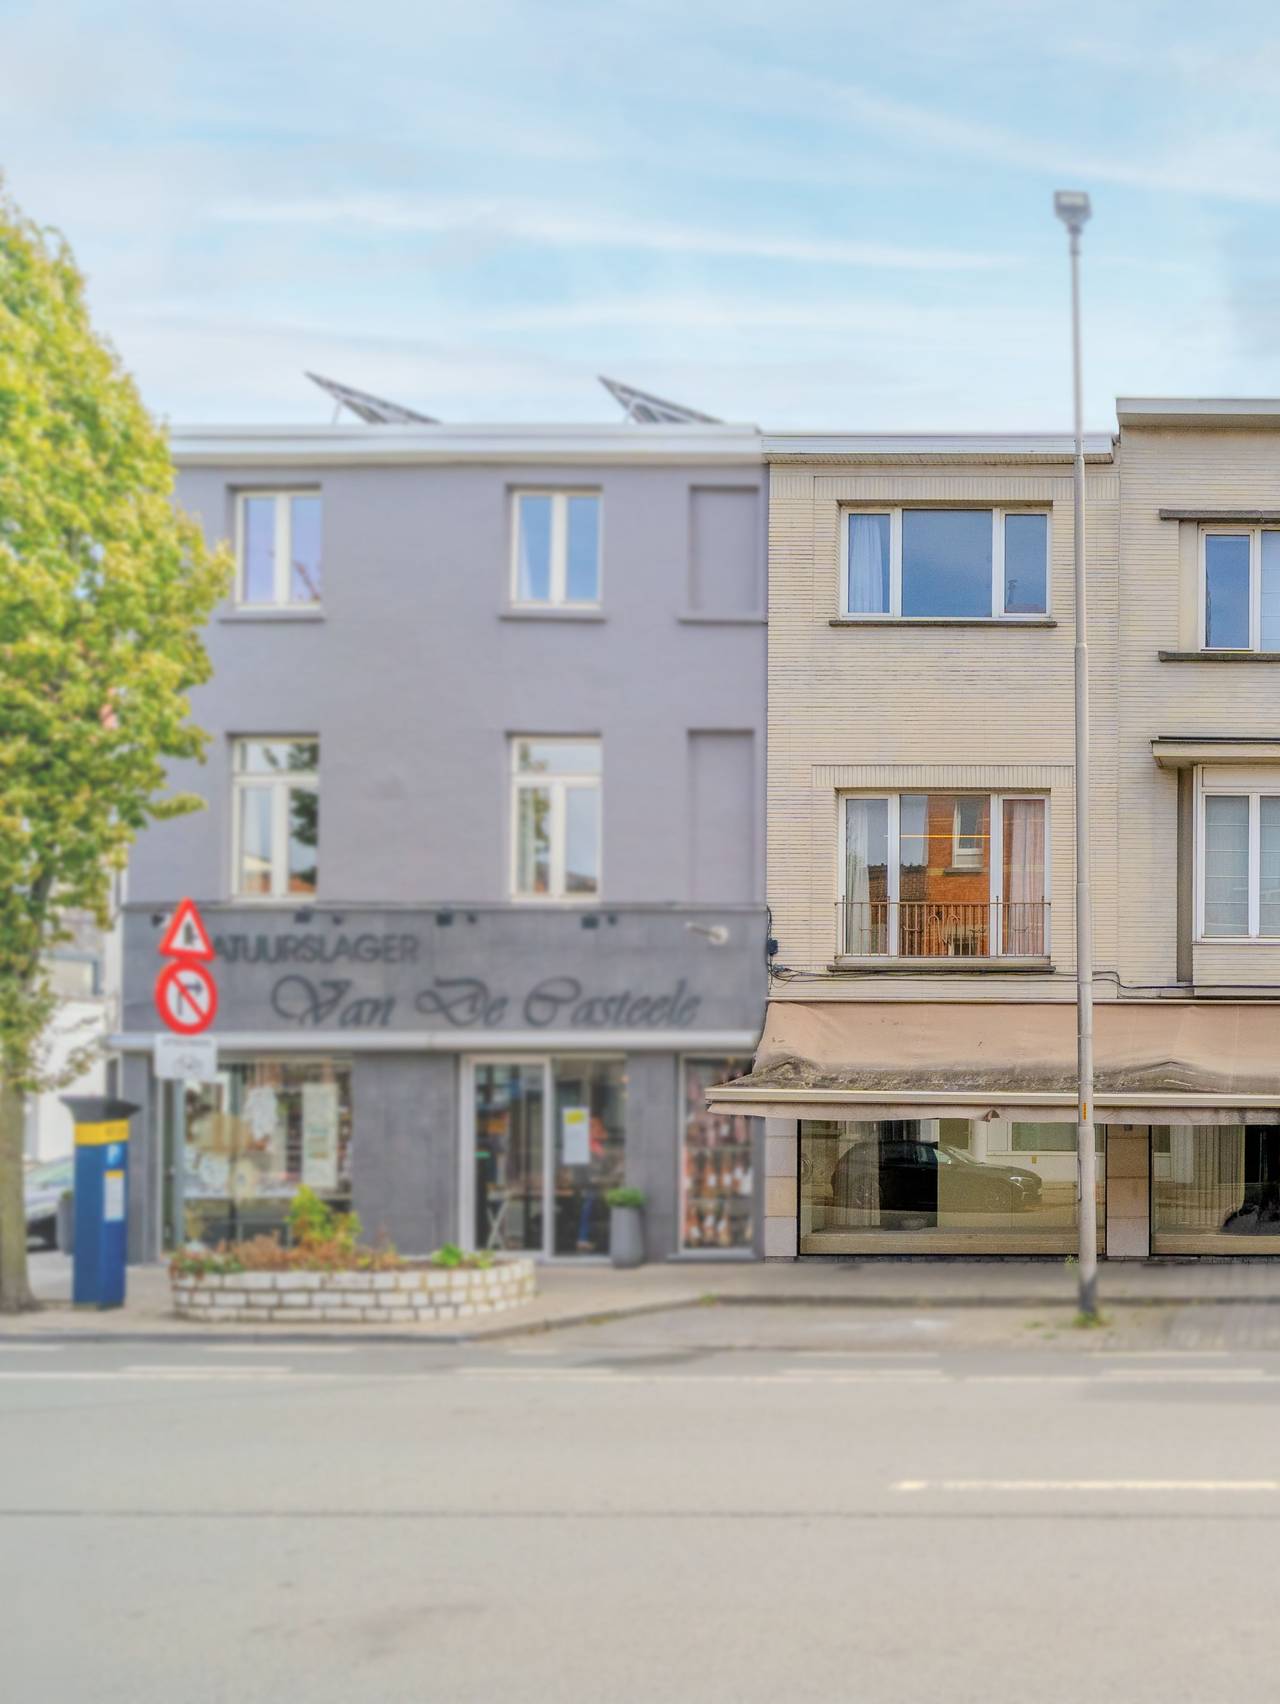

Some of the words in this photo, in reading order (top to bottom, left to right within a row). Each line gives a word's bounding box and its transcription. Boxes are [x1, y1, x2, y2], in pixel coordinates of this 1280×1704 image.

[214, 933, 418, 963] ATUURSLAGER
[271, 974, 396, 1027] Van
[415, 977, 508, 1028] De
[523, 975, 701, 1028] Casteele
